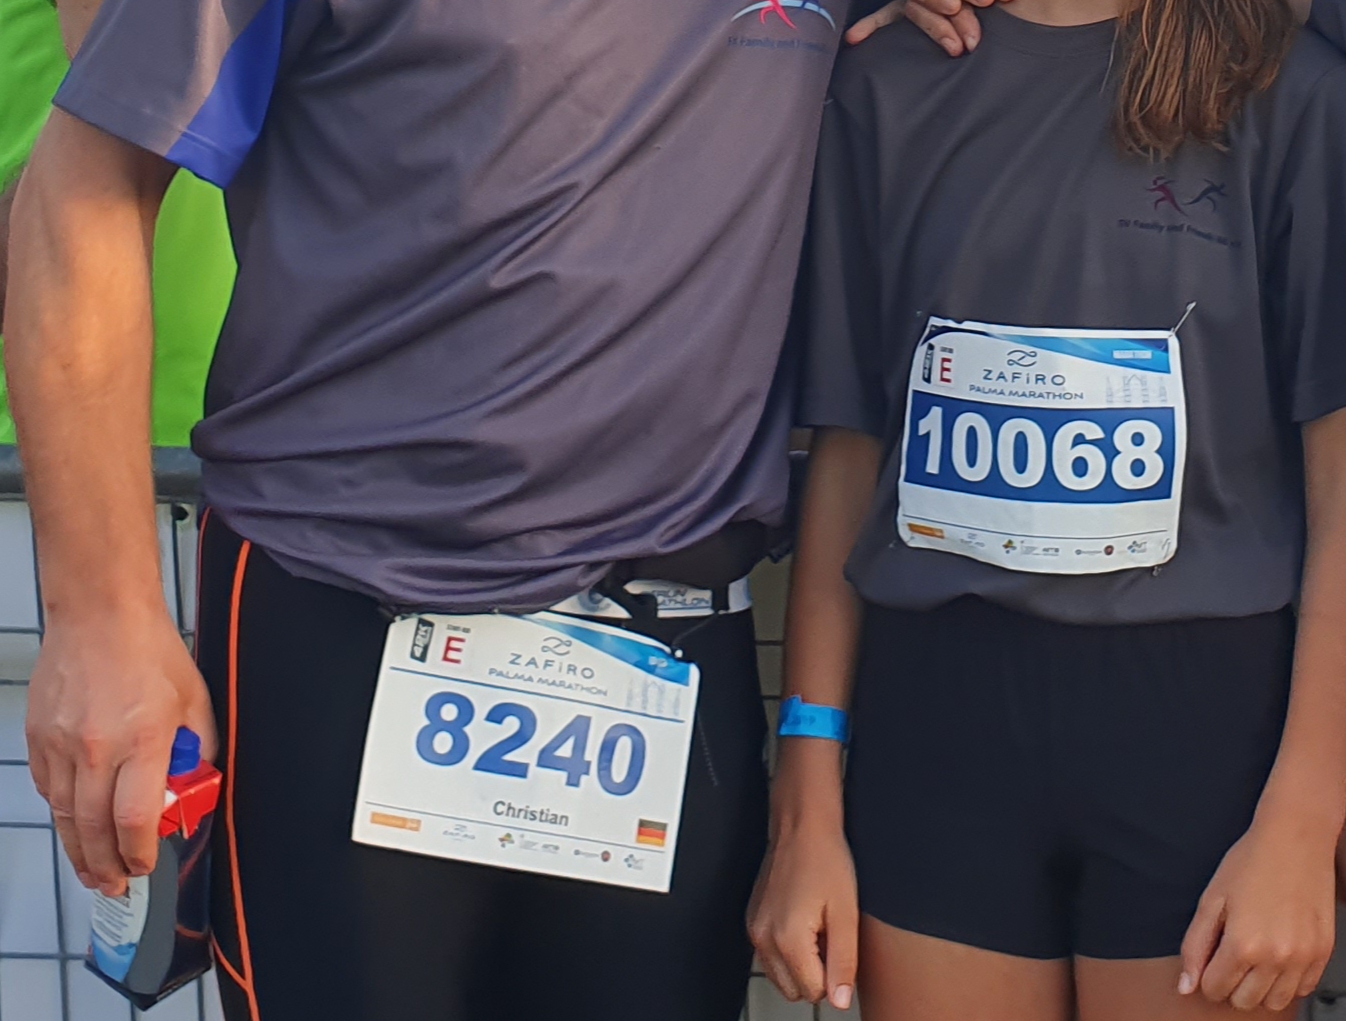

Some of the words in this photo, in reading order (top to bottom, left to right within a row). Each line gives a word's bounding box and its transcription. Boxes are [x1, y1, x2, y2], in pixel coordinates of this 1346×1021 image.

[940, 357, 953, 383] E
[969, 384, 1006, 397] PALMA
[1008, 390, 1084, 401] MARATHON
[918, 406, 1164, 491] 10068
[441, 635, 466, 664] E
[488, 668, 534, 683] PALMA
[536, 677, 608, 697] MARATHON
[415, 691, 646, 796] 8240
[493, 800, 569, 827] Christian
